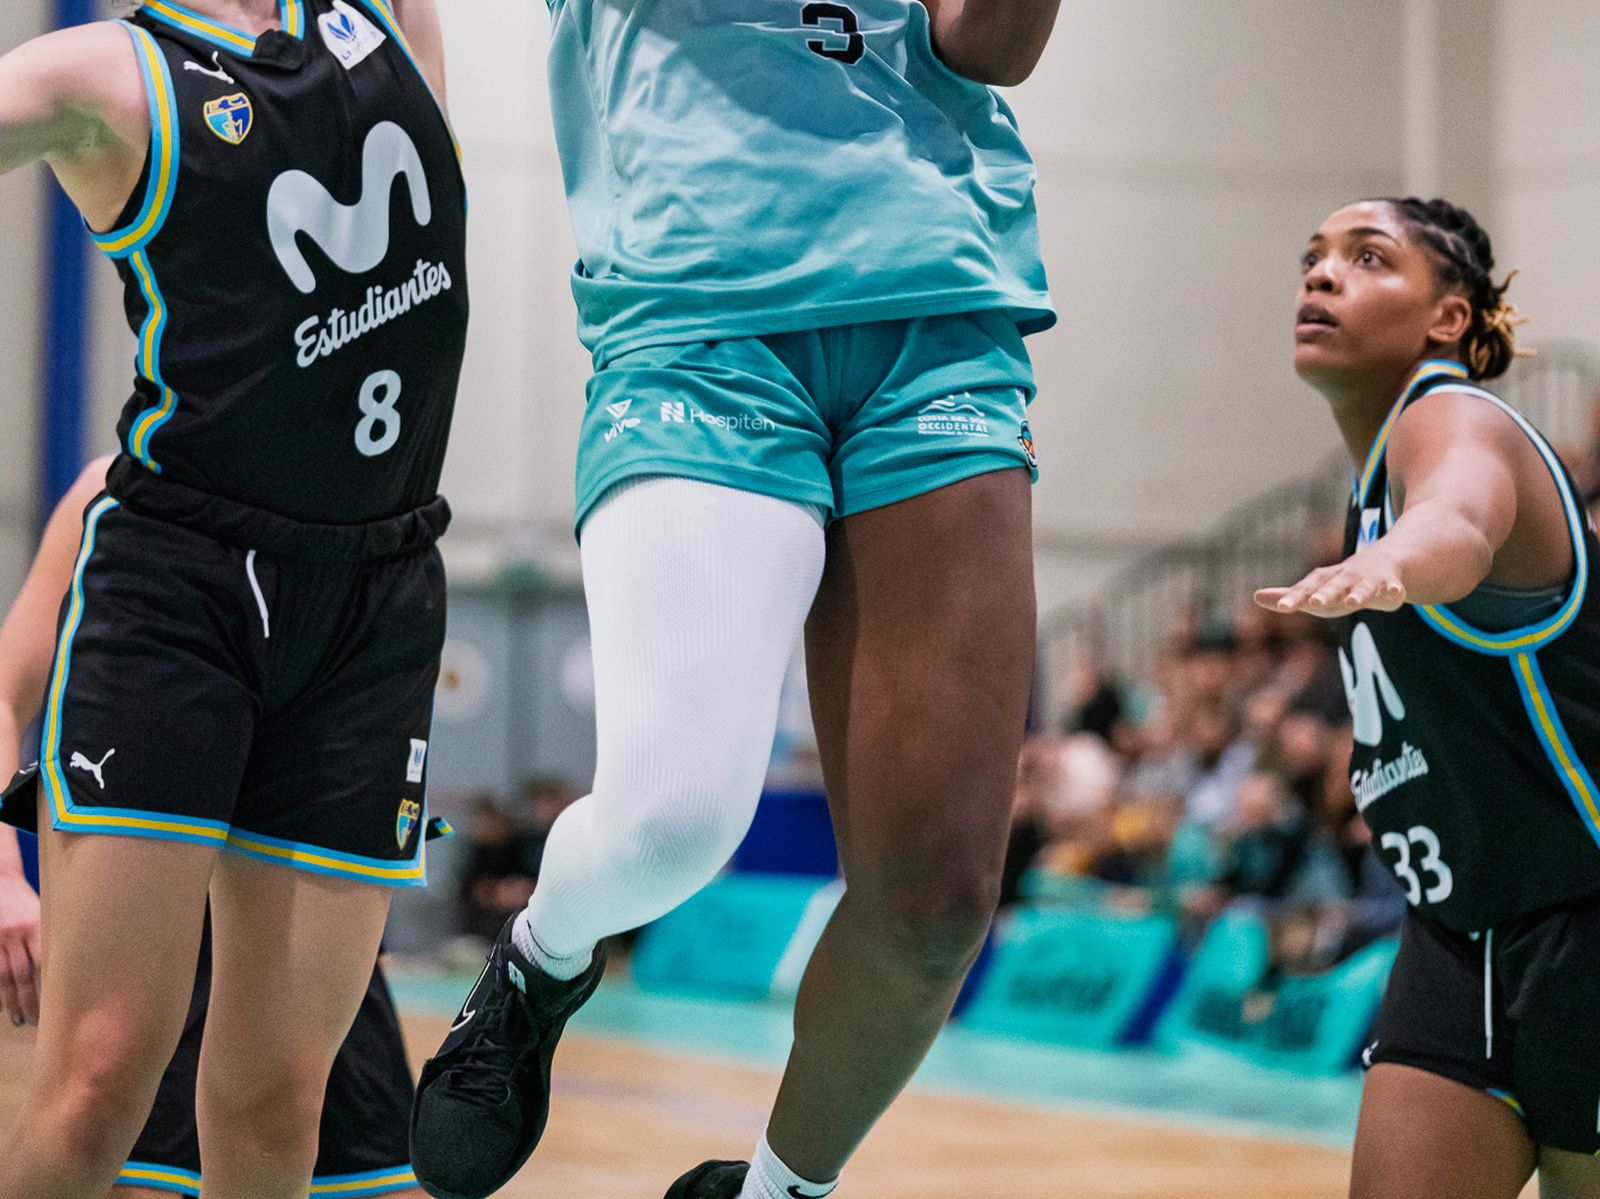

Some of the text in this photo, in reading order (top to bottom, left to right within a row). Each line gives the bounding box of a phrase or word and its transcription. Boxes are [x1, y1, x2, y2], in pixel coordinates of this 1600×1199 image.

[800, 2, 866, 65] 3
[294, 258, 452, 368] Estudiantes
[354, 369, 401, 457] 8
[690, 408, 776, 431] Hospiten
[918, 422, 988, 433] OCCIDENTAL
[1381, 825, 1453, 906] 33
